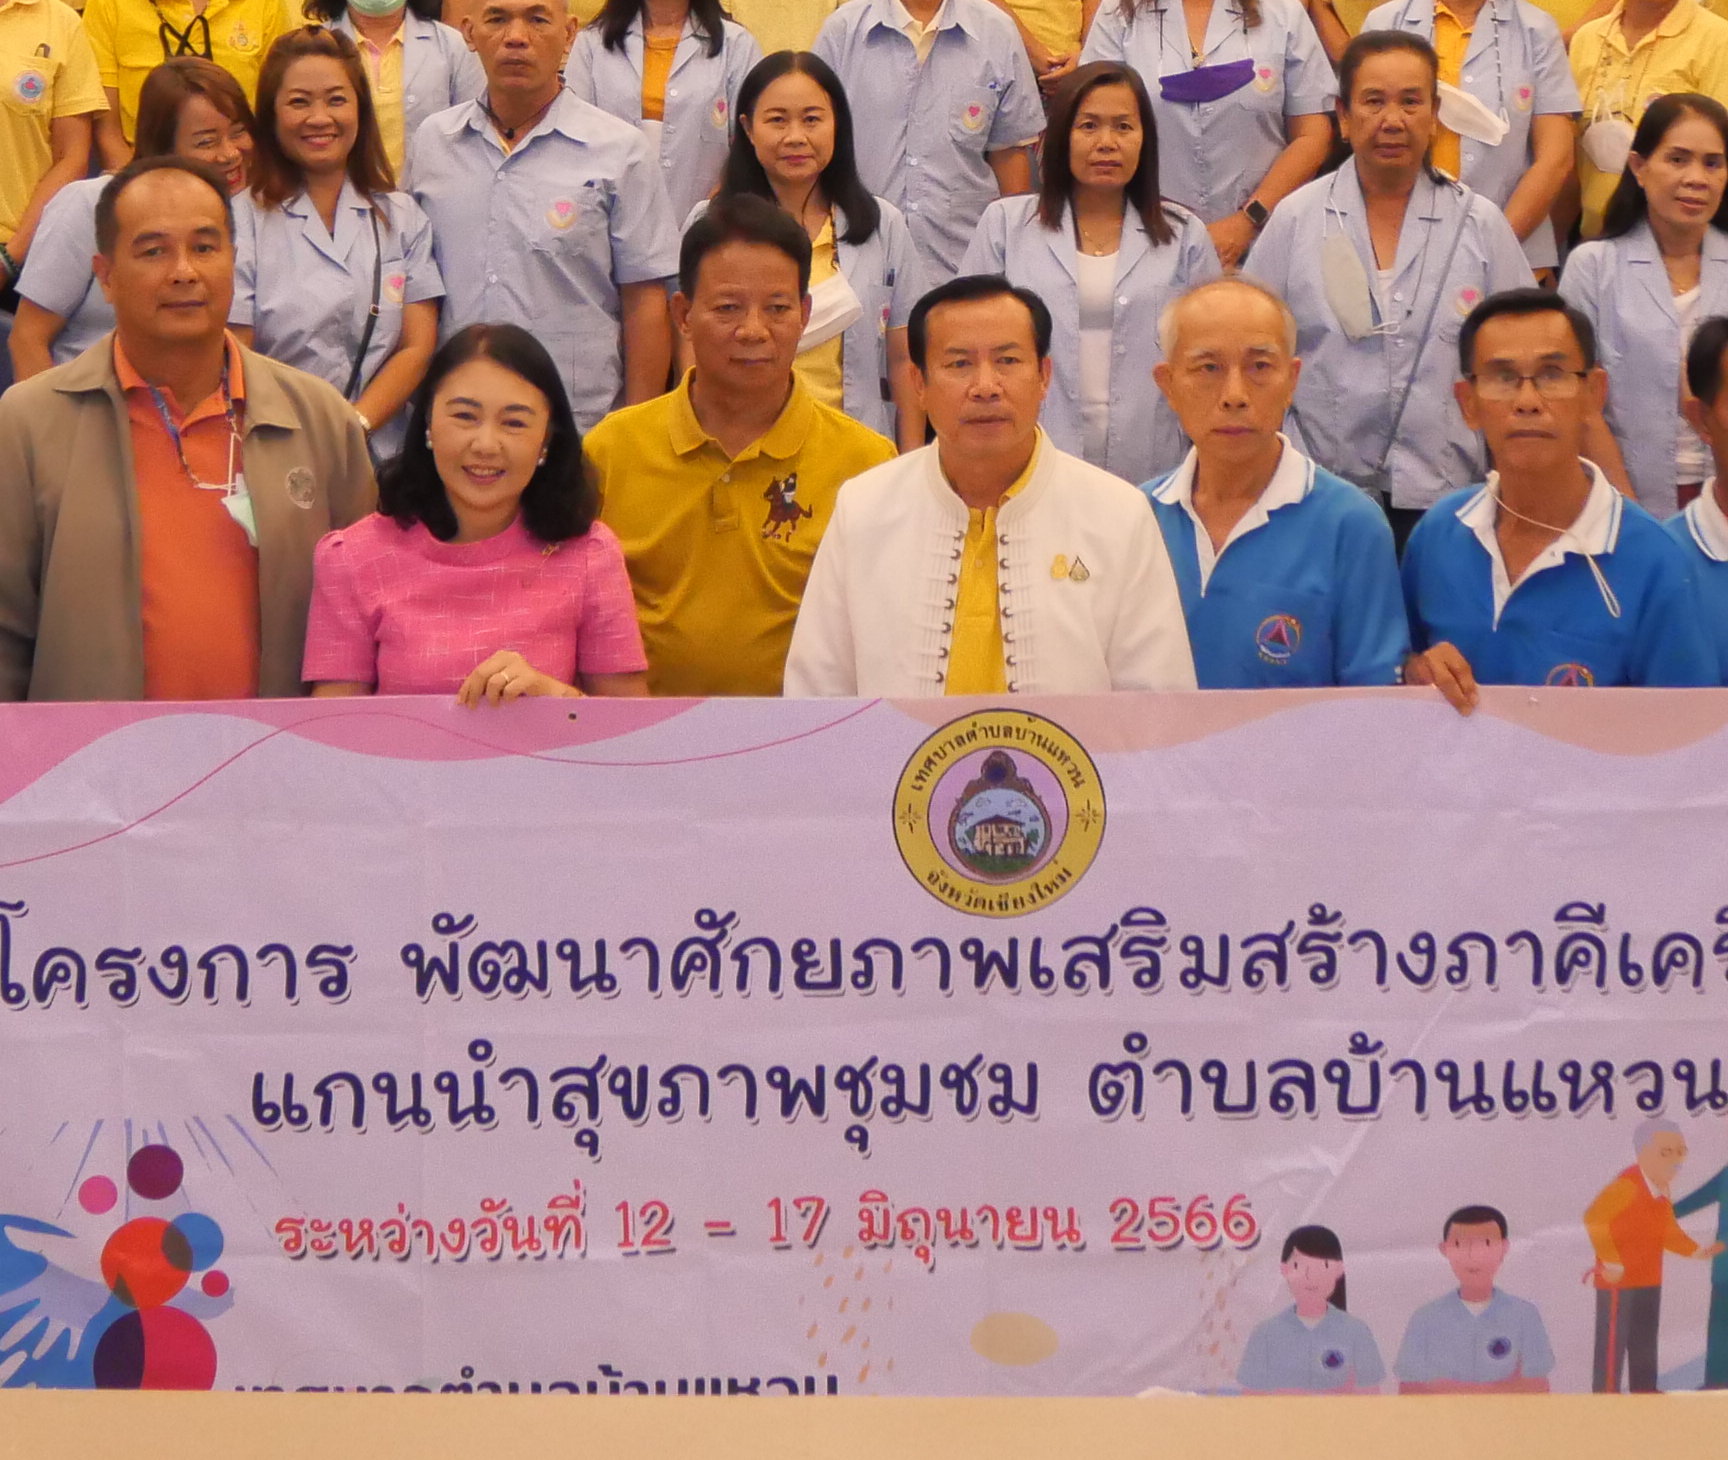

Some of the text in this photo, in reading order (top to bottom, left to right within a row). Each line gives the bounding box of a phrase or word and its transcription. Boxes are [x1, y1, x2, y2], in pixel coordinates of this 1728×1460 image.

[252, 1039, 1040, 1158] แกนนำสุขภาพชุมชม
[275, 1179, 585, 1258] ระหว่างวันที่
[616, 1199, 673, 1252] 12
[767, 1195, 828, 1246] 17
[858, 1188, 1085, 1267] มิถุนายน
[1109, 1193, 1260, 1247] 2566
